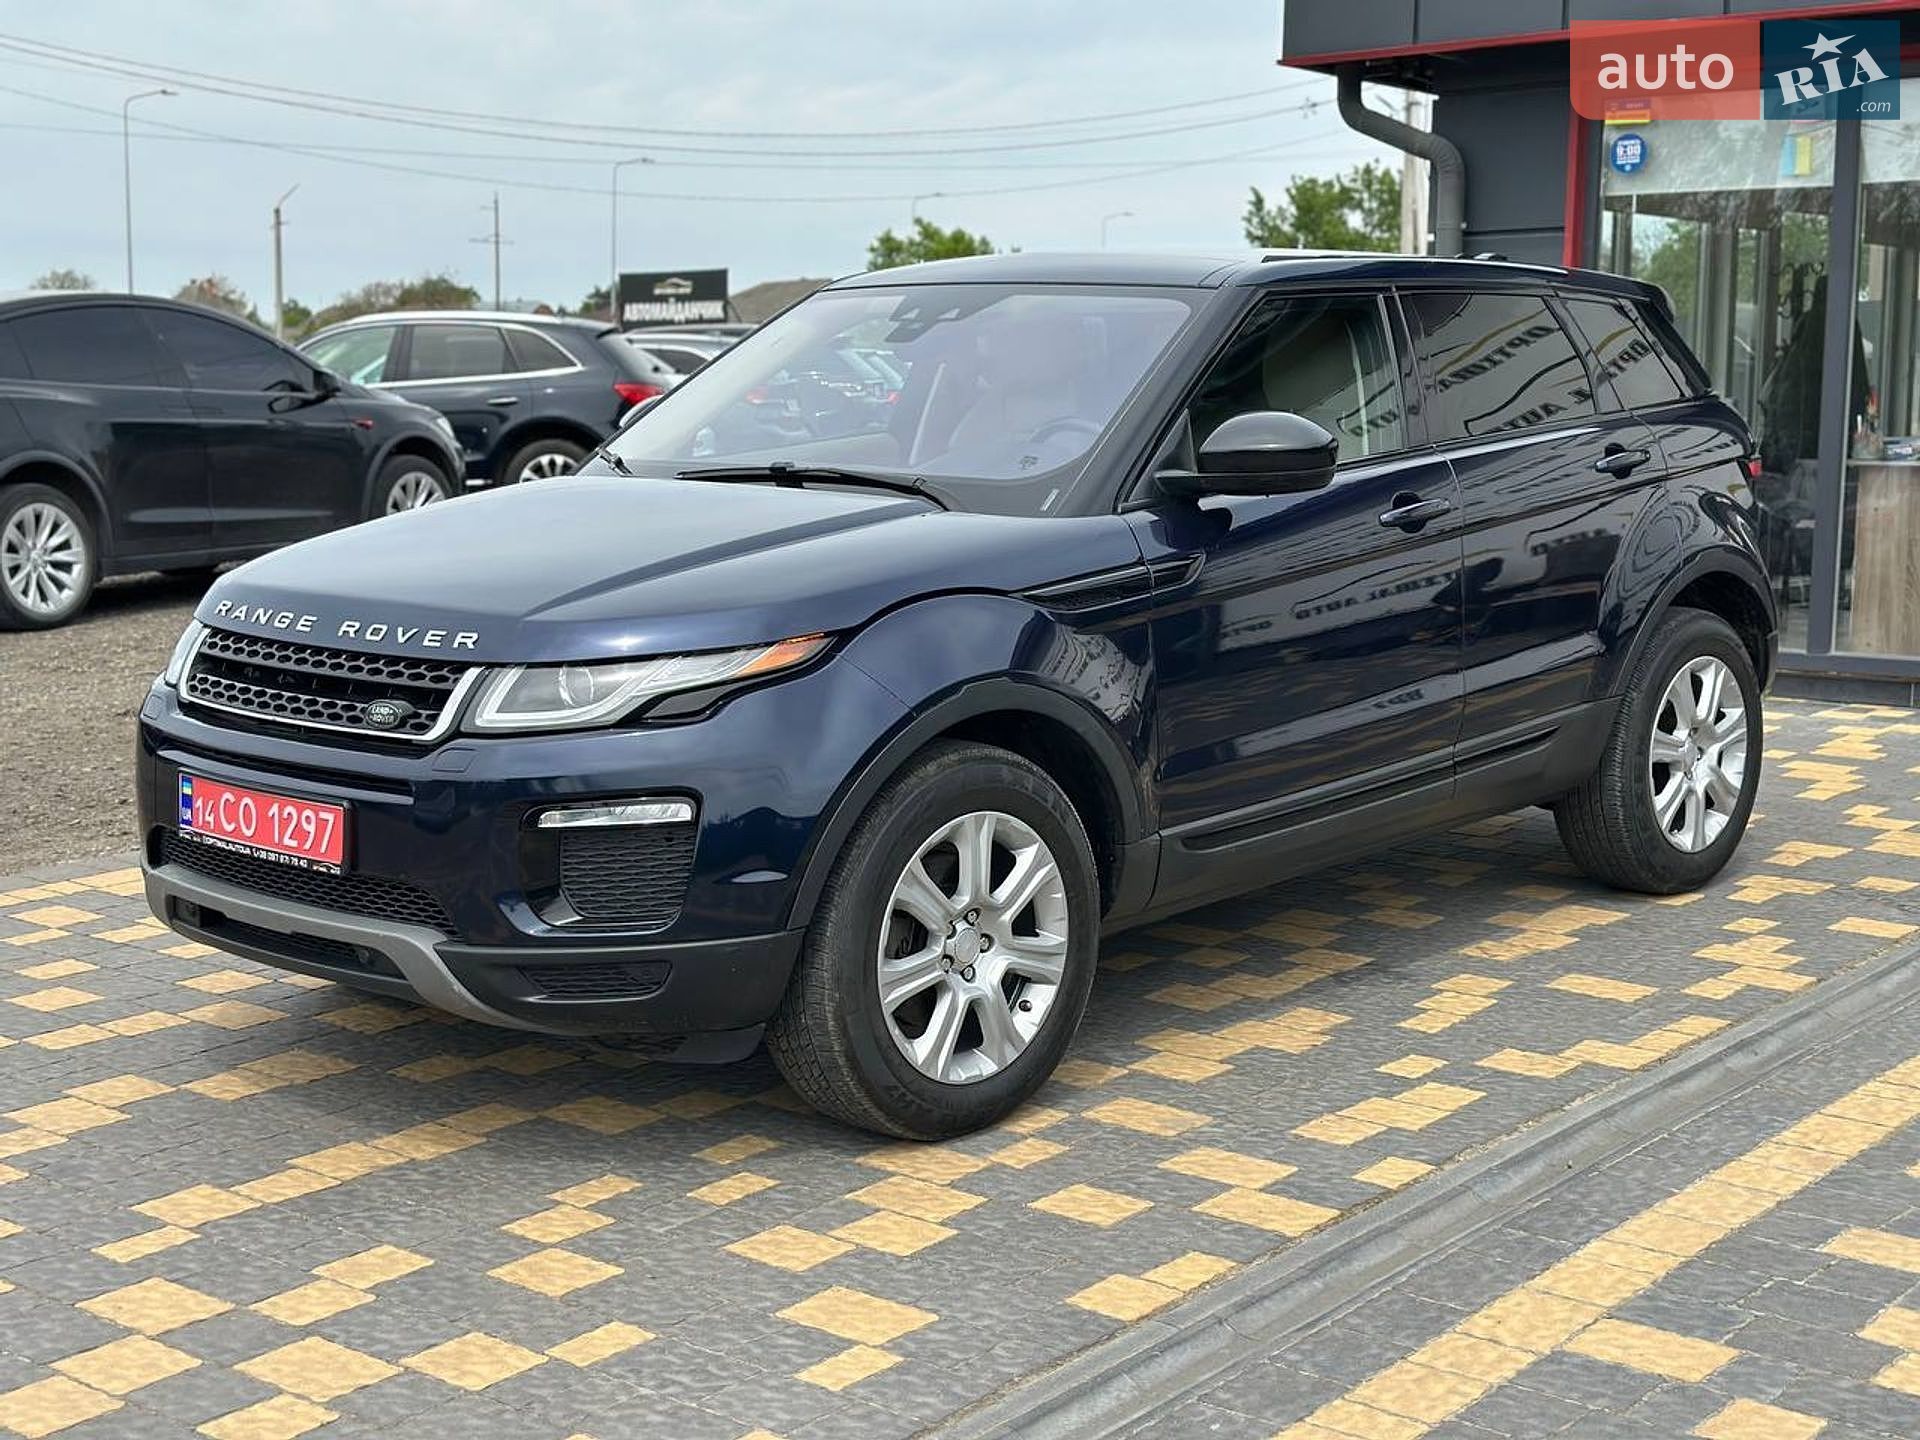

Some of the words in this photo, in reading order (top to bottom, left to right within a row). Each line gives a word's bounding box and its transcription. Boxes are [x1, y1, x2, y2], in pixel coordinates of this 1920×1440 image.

[215, 600, 318, 633] RANGE
[338, 620, 480, 650] ROVER
[268, 802, 336, 854] 1297
